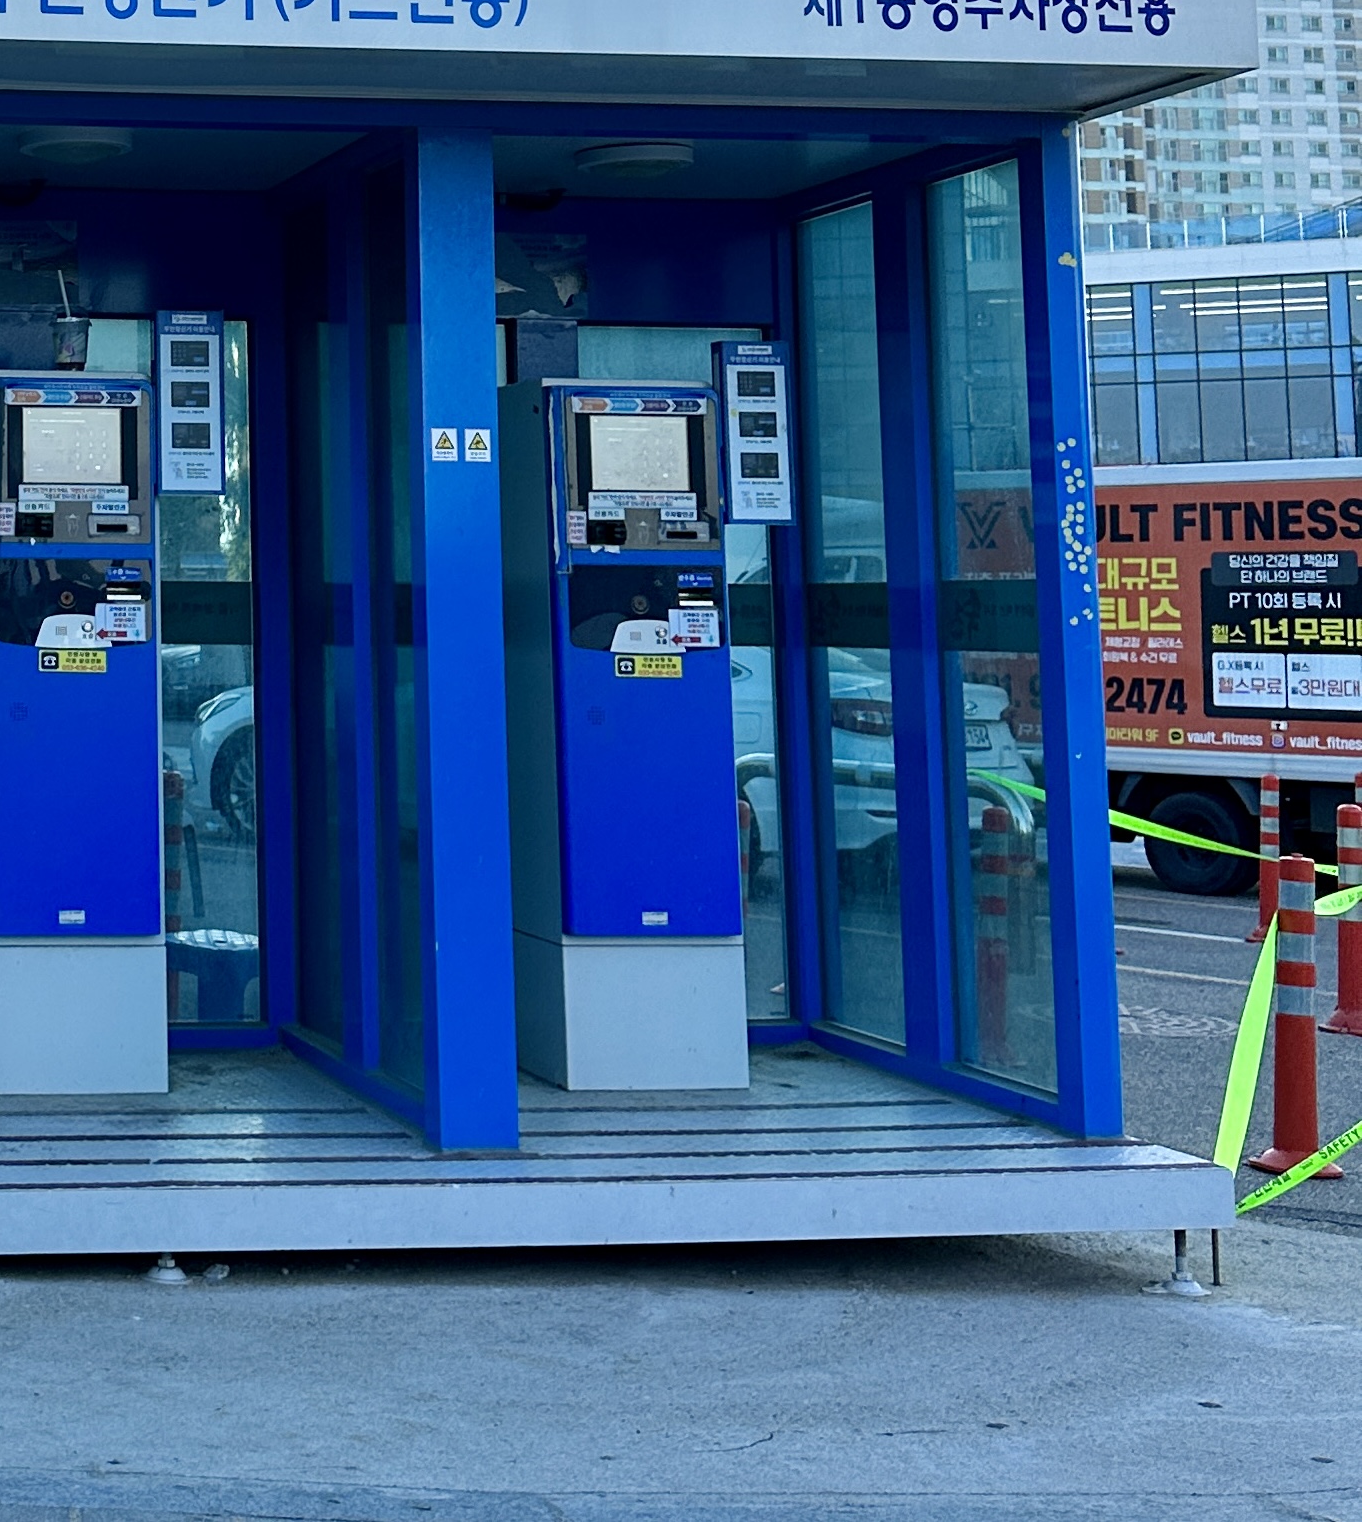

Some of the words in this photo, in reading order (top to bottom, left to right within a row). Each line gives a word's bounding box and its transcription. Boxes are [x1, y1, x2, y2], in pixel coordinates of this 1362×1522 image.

[1173, 498, 1362, 542] FITNESS
[1229, 554, 1264, 568] 당신의
[1254, 569, 1290, 584] 하나의
[1228, 592, 1252, 609] PT
[1254, 591, 1288, 609] 10회
[1325, 592, 1342, 609] 시
[1211, 623, 1247, 644] 헬스
[1249, 617, 1289, 646] 1년
[1105, 676, 1188, 715] 2474
[1318, 1127, 1362, 1160] SAFETY
